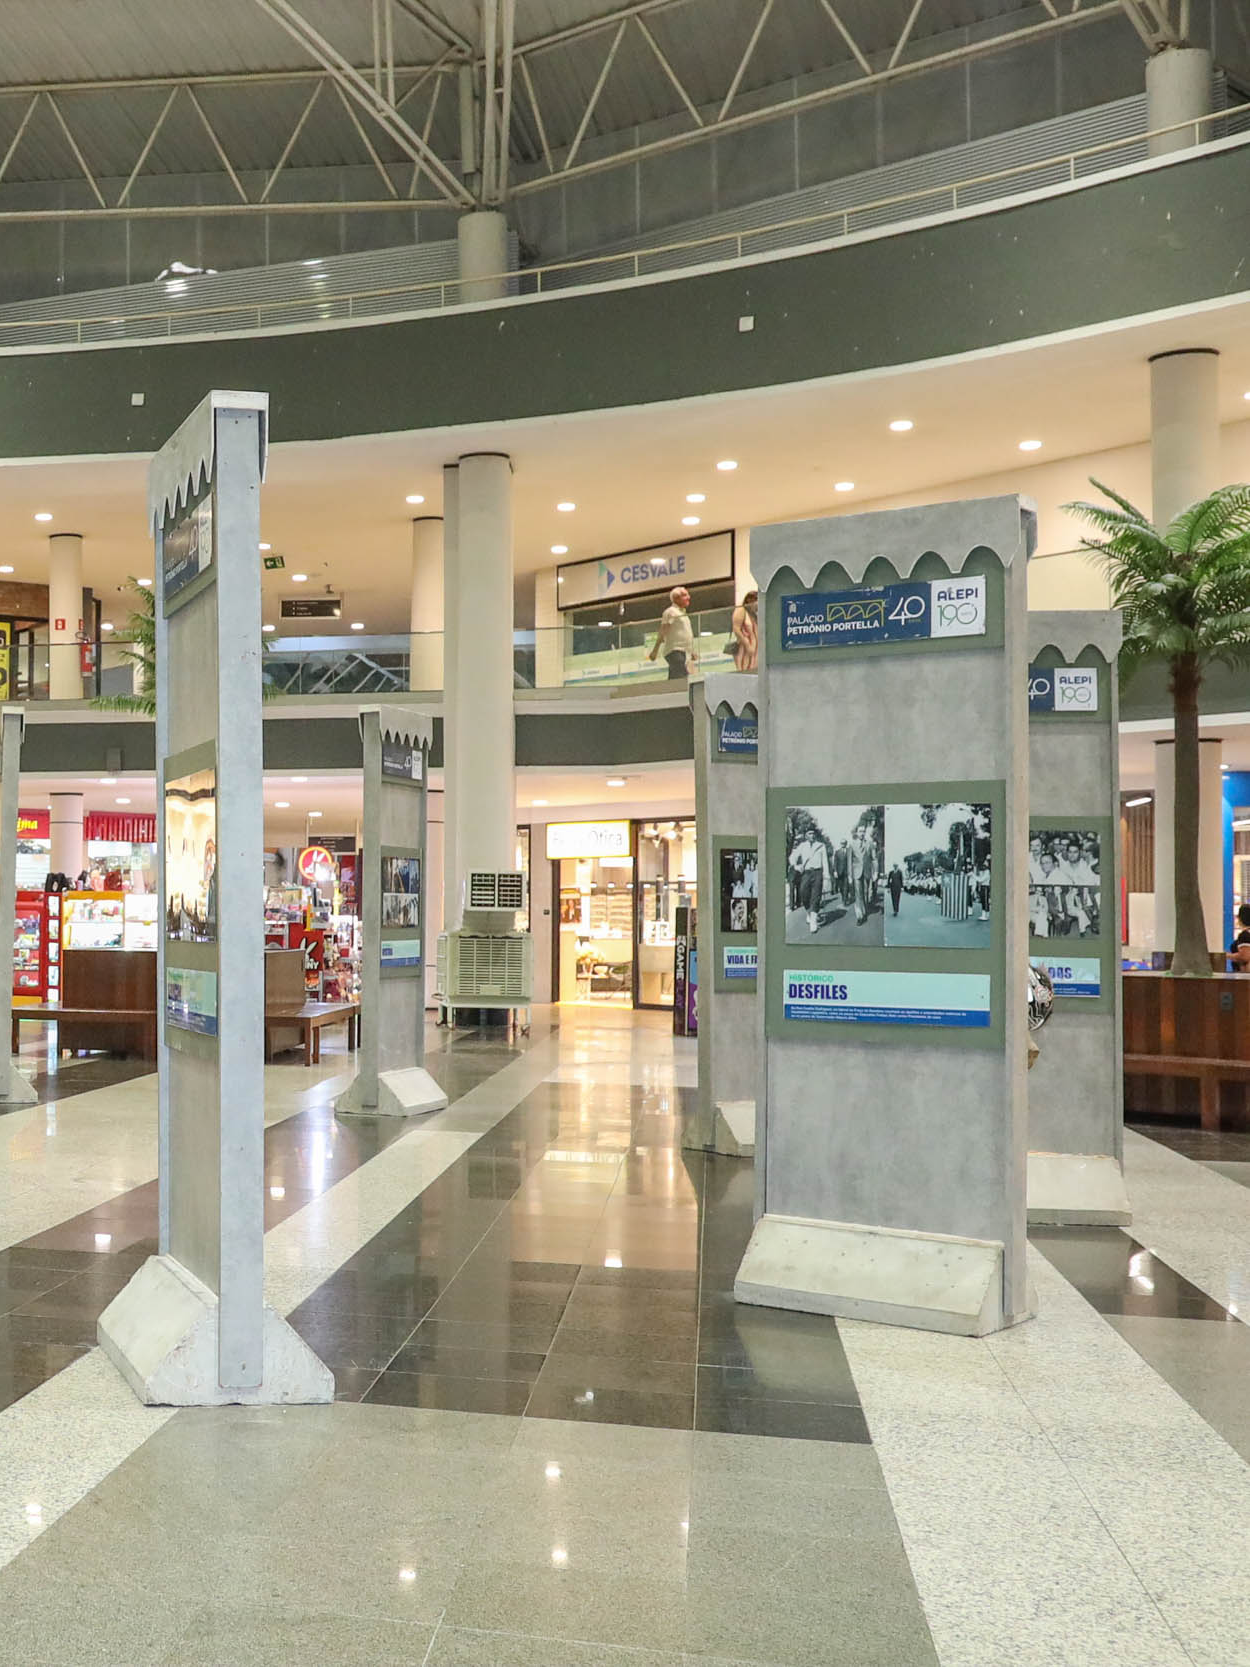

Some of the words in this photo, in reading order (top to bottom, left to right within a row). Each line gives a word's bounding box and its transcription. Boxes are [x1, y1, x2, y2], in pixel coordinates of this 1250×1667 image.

[621, 556, 686, 583] CESVALE
[937, 588, 979, 601] ALEPI
[888, 595, 926, 626] 40
[936, 602, 978, 626] 190
[787, 614, 824, 625] PALÁCIO
[787, 623, 832, 635] PETRÔNIO
[833, 621, 880, 632] PORTELLA
[1059, 675, 1092, 685] ALEPI
[1060, 686, 1092, 703] 190
[789, 974, 835, 983] HISTÓRICO
[788, 983, 848, 1000] DESFILES
